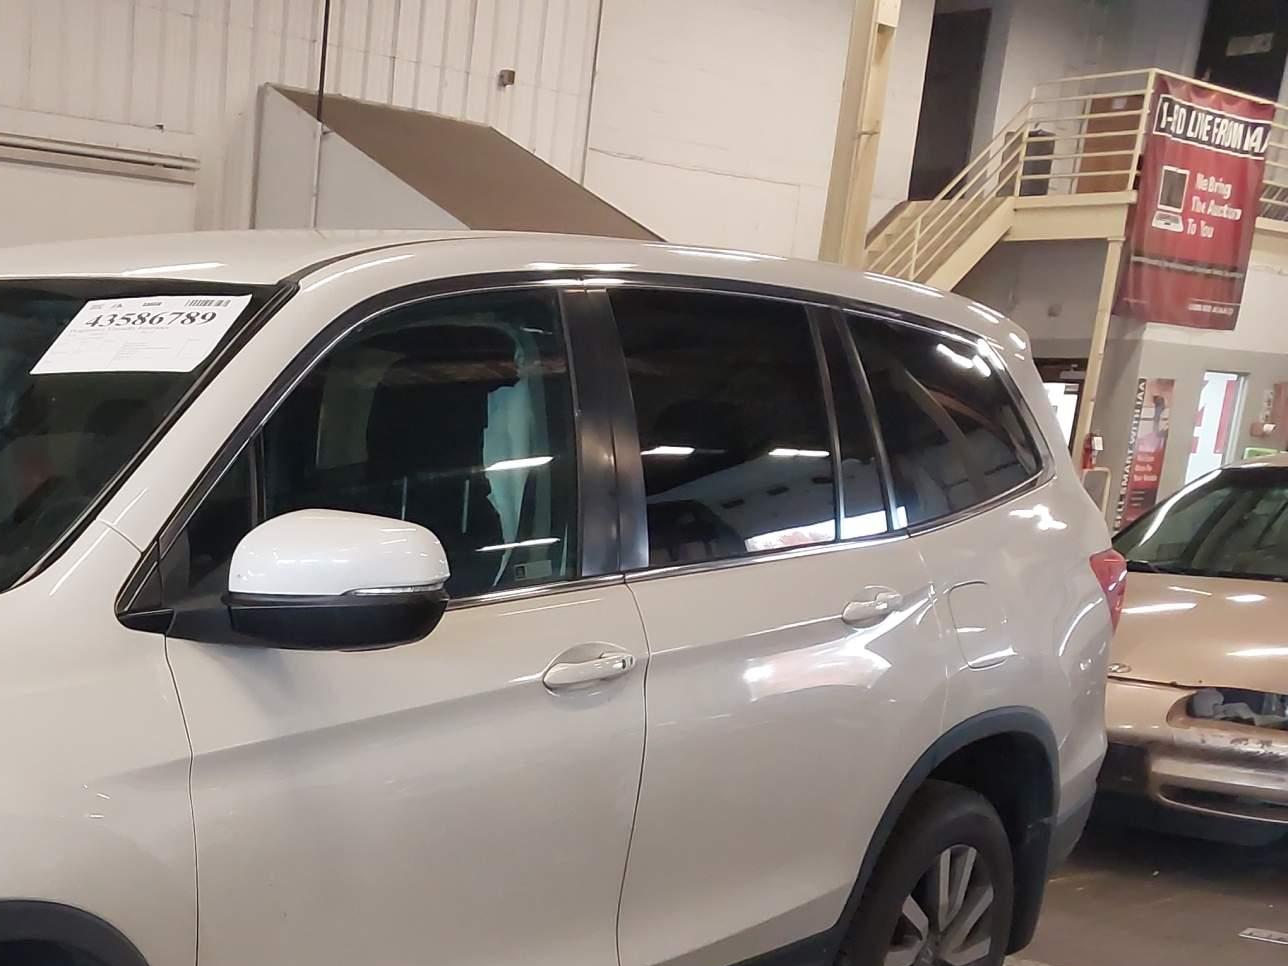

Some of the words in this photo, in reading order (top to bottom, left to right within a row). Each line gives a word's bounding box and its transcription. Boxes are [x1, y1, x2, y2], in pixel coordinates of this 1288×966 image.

[1212, 117, 1244, 149] FROM
[85, 311, 217, 328] 43586789
[1128, 408, 1141, 445] WITH
[1135, 381, 1146, 405] IAA
